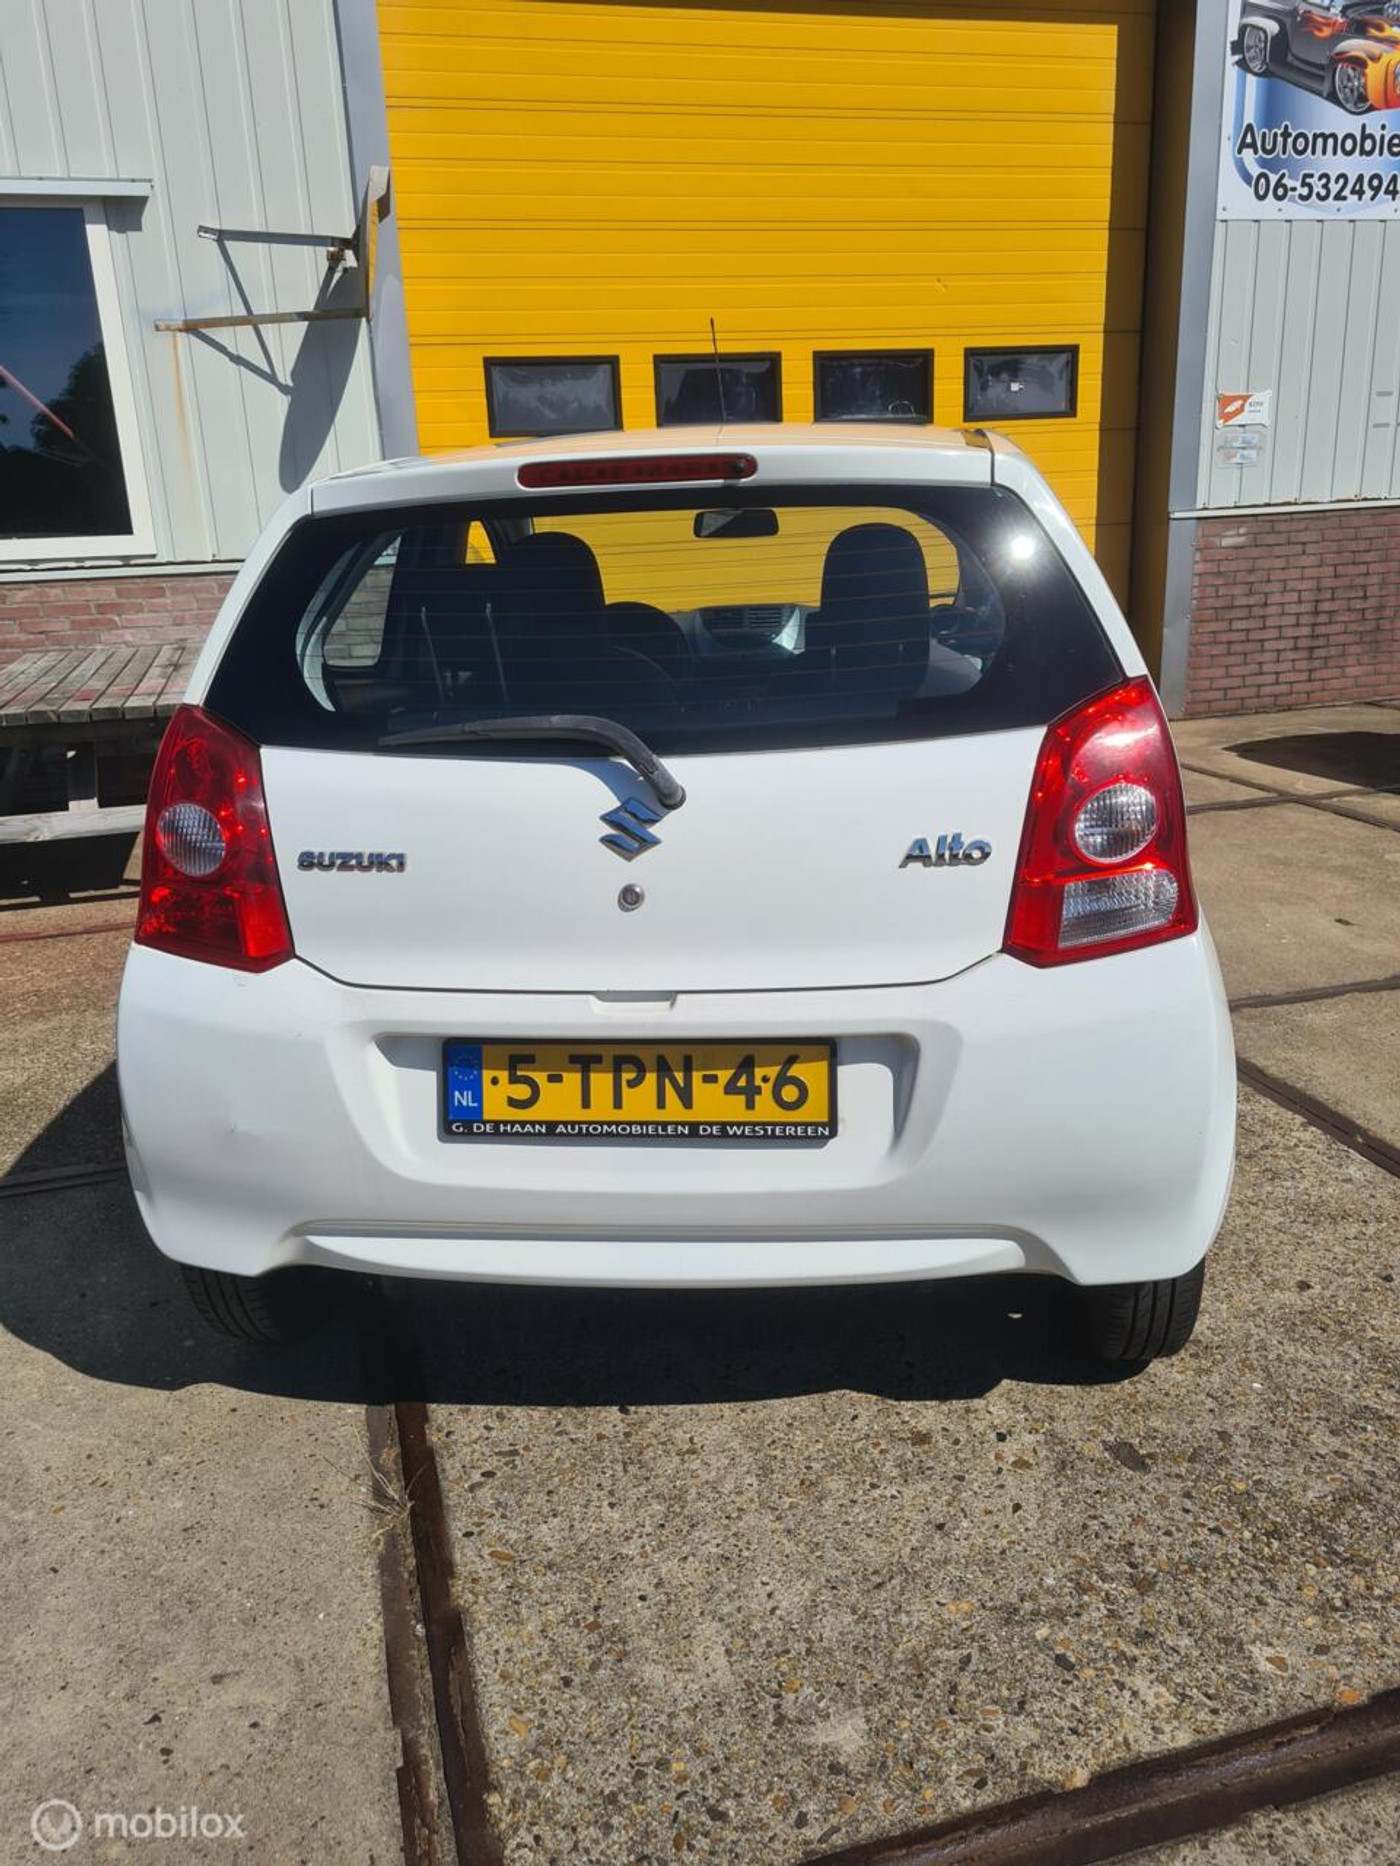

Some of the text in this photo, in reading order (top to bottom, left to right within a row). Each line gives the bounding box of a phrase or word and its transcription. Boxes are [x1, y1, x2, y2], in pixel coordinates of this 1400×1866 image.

[1237, 122, 1400, 157] Automobie
[1254, 171, 1400, 202] 06-532494
[297, 851, 407, 873] SUZUKI
[898, 832, 992, 869] Alto
[506, 1053, 809, 1111] 5-TPN-46
[454, 1090, 477, 1107] NL
[452, 1122, 830, 1137] G. DE HAAN AUTOMOBIELEN DE WESTEREEN
